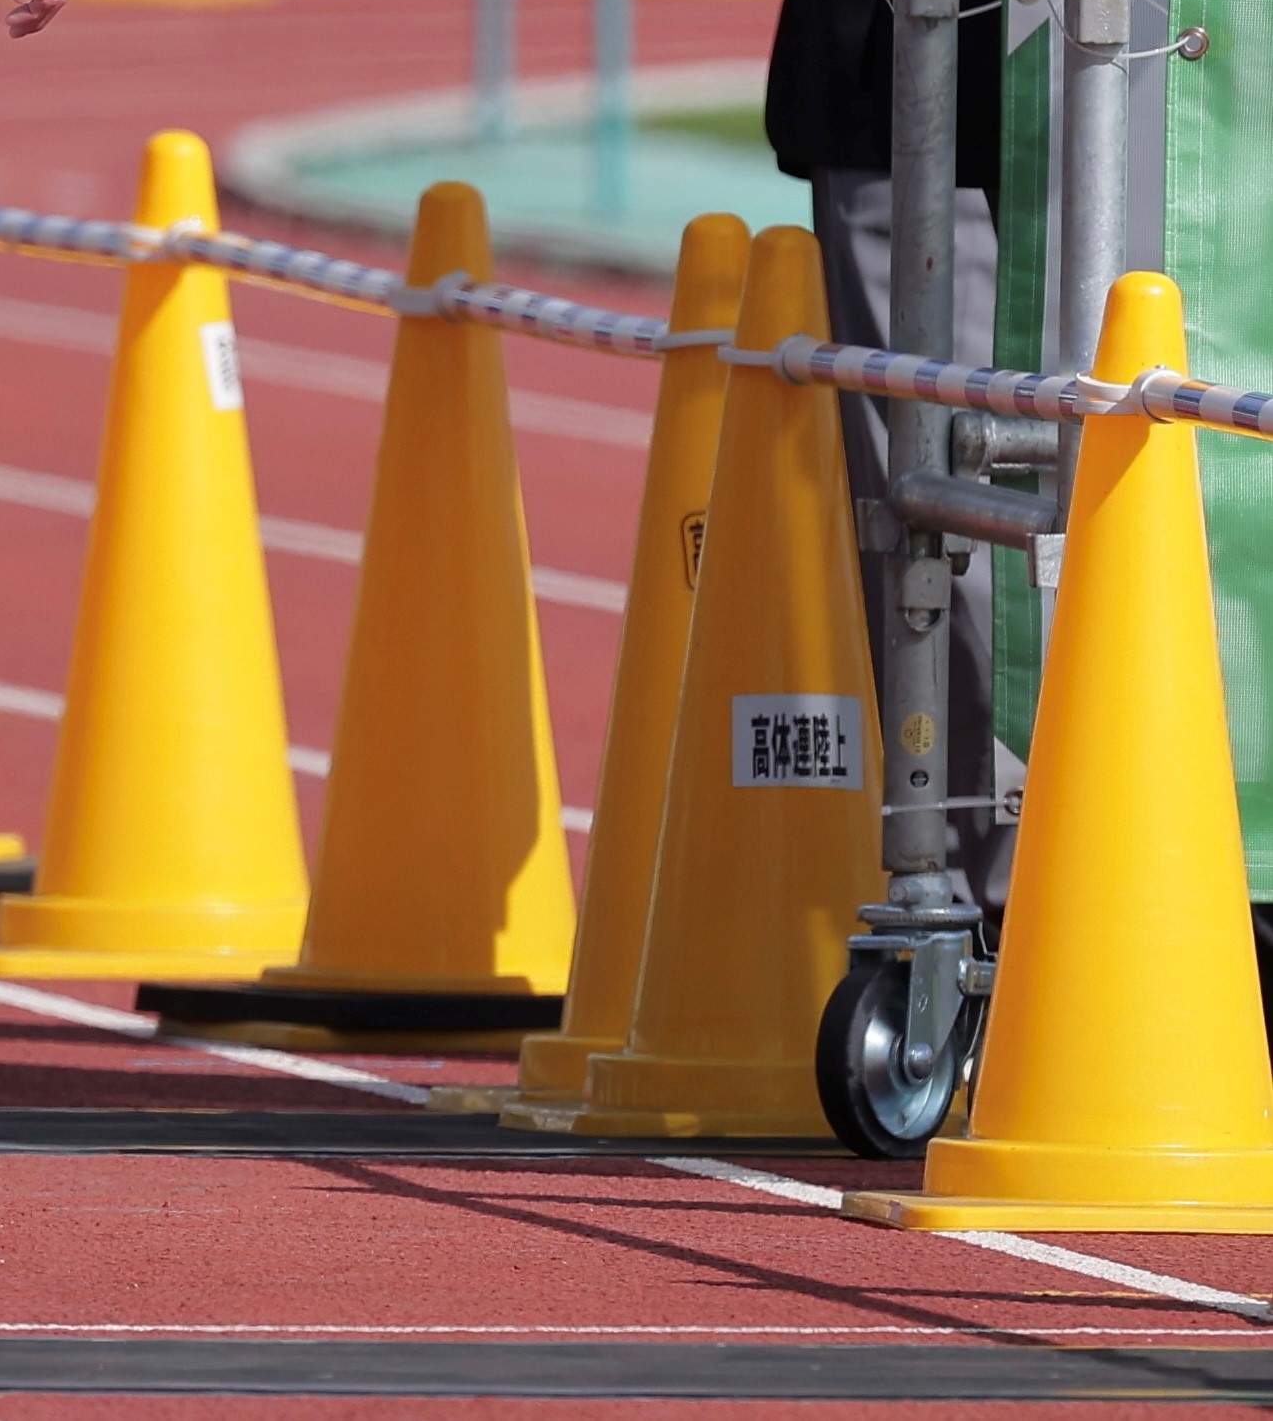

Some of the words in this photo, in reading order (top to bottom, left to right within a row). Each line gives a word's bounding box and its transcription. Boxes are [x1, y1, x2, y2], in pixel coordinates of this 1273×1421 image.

[751, 712, 847, 779] 高体連陸上
